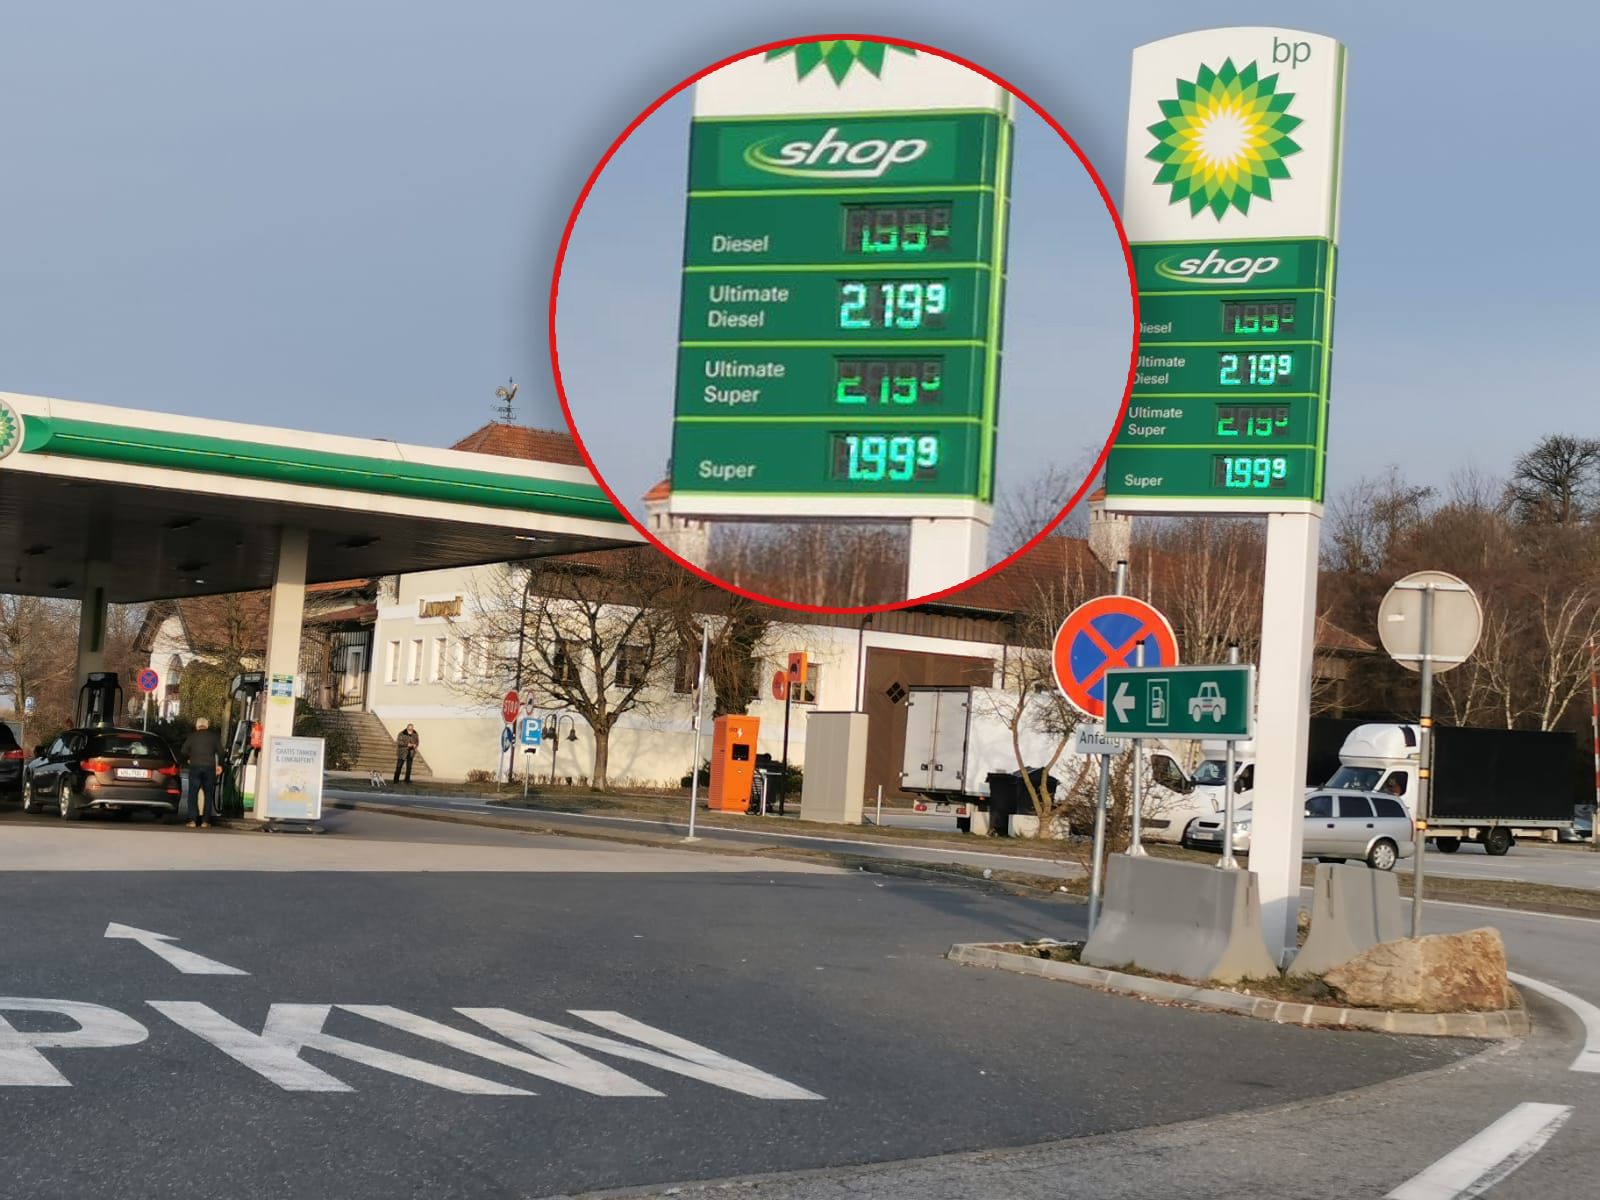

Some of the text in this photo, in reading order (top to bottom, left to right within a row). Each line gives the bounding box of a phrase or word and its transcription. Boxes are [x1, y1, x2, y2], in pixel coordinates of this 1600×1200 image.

[1271, 36, 1312, 70] bp
[773, 127, 929, 178] shop
[711, 234, 770, 253] Diesel
[1177, 249, 1280, 284] shop
[708, 284, 790, 303] Ultimate
[707, 309, 765, 328] Diesel
[704, 360, 786, 378] Ultimate
[703, 384, 761, 406] Super
[1128, 406, 1184, 419] Ultimate
[1127, 423, 1167, 438] Super
[698, 459, 757, 481] Super
[1124, 473, 1164, 489] Super
[503, 700, 519, 715] STOP
[0, 997, 827, 1100] PKW
